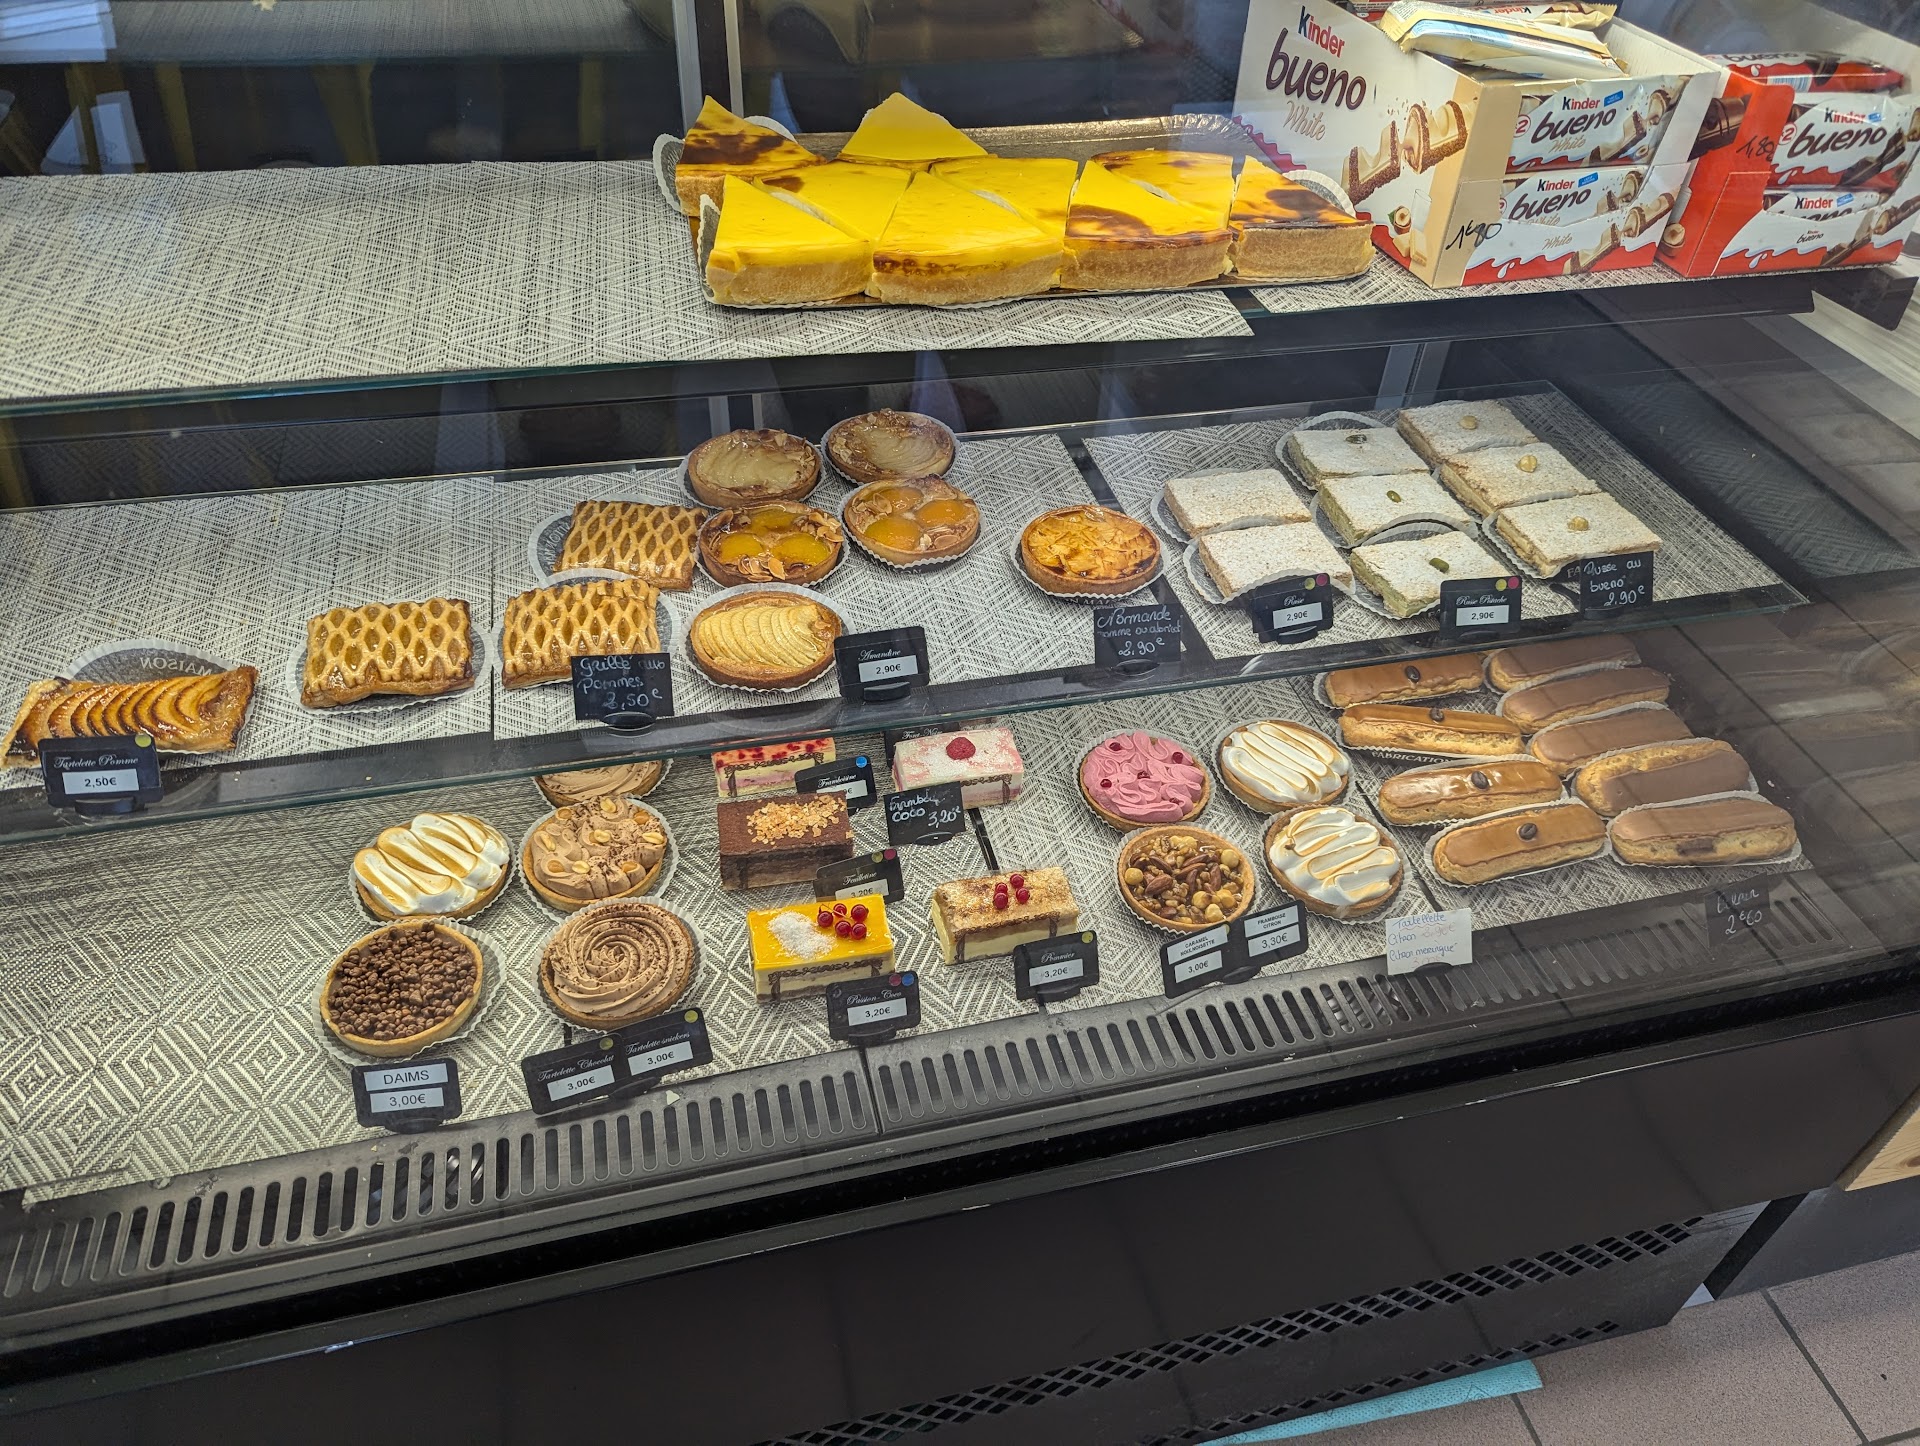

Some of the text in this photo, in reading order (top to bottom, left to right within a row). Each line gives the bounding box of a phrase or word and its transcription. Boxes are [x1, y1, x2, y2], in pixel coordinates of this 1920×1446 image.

[1265, 27, 1367, 111] bueno
[1283, 100, 1326, 141] White
[1530, 108, 1617, 144] bueno
[1786, 123, 1888, 159] bueno
[1508, 188, 1592, 221] bueno
[1541, 233, 1573, 250] White
[1626, 559, 1642, 569] au
[1286, 610, 1308, 622] 2,90€
[1471, 611, 1495, 621] 2,90€
[858, 648, 902, 661] Amandine
[875, 663, 902, 676] 2,90€
[53, 753, 139, 769] Tartelette Pomme
[84, 777, 117, 788] 2,50€
[1257, 912, 1286, 925] FRAMBOISE
[1263, 920, 1282, 929] CITRON
[1184, 936, 1209, 948] CARAMEL
[1261, 932, 1288, 949] 3,30€
[1044, 967, 1069, 978] 3,20€
[1187, 960, 1209, 974] 3,00€
[864, 1007, 891, 1018] 3,20€
[625, 1040, 661, 1056] Tartelette
[647, 1051, 675, 1065] 3,00€
[537, 1054, 615, 1082] Tartelette Chocolat
[383, 1069, 430, 1085] DAIMS
[567, 1076, 596, 1091] 3,00€
[389, 1093, 426, 1108] 3,00€
